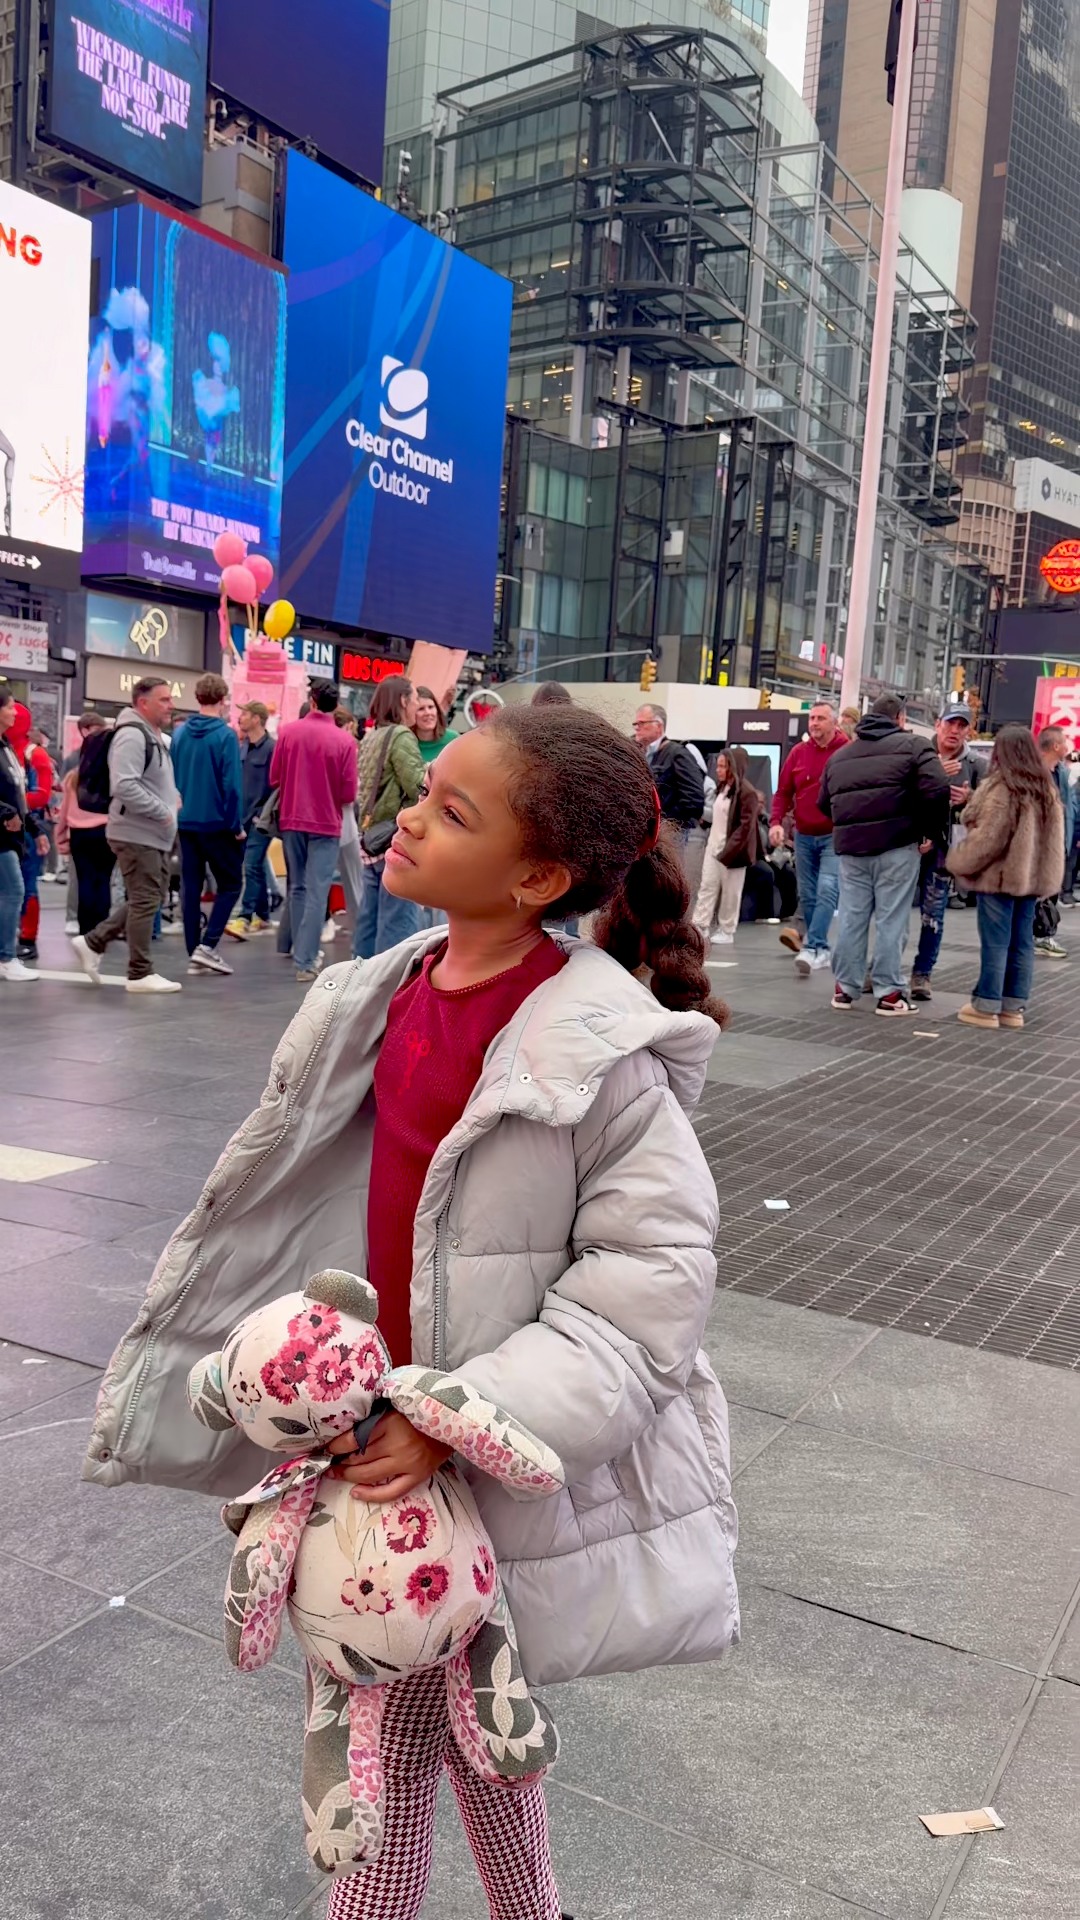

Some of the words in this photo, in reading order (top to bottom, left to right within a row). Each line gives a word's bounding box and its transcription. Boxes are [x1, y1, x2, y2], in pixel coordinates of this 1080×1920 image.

[77, 45, 103, 82] THE
[107, 62, 158, 111] LAUGHS
[162, 94, 188, 129] ARE
[148, 61, 191, 106] FUNNY!
[0, 222, 43, 266] NG
[345, 419, 391, 459] Clear
[391, 437, 453, 484] Channel
[368, 461, 430, 505] Outdoor
[1054, 486, 1080, 506] HYAT
[25, 650, 34, 665] 3
[302, 638, 334, 665] FIN
[343, 653, 371, 681] DOS
